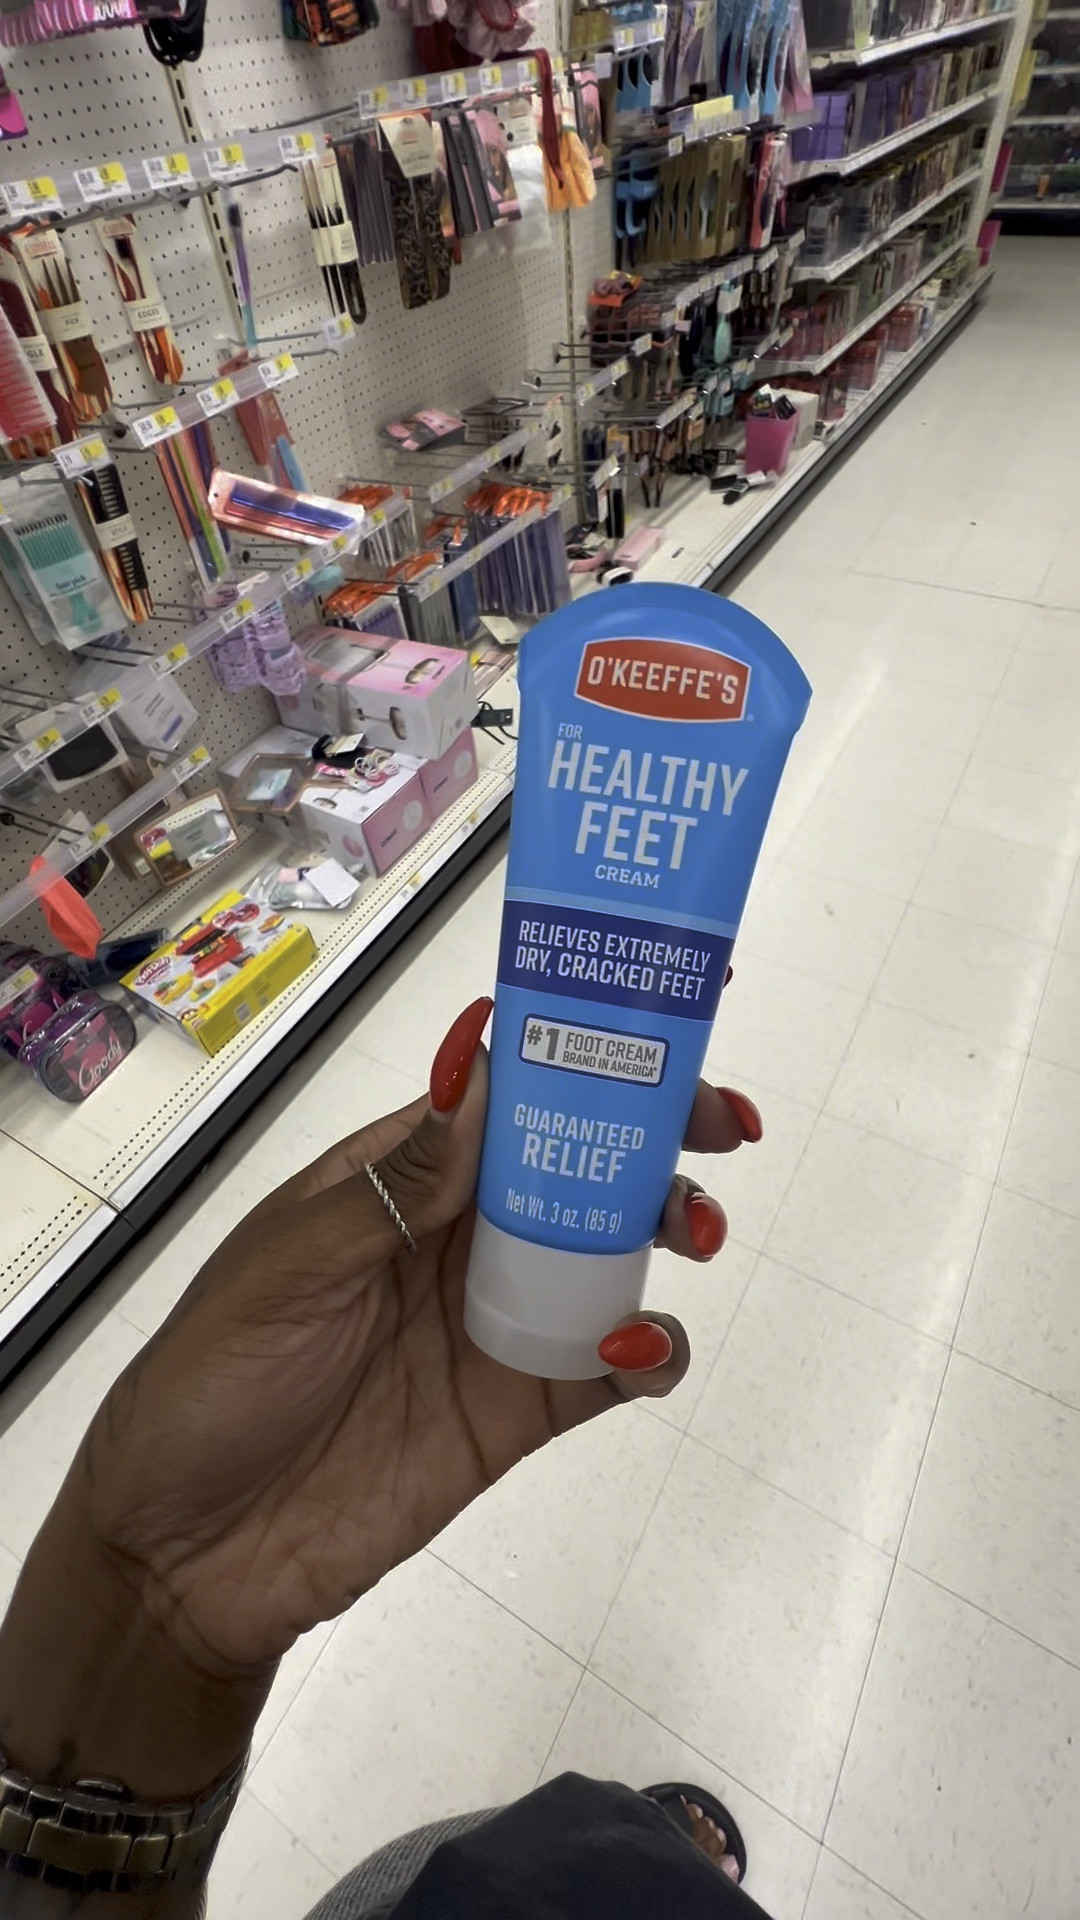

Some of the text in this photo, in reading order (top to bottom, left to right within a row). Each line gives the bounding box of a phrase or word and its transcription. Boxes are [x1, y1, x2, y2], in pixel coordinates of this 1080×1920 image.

[587, 655, 739, 705] O'KEEFFE'S
[558, 722, 583, 740] FOR
[547, 739, 749, 816] HEALTHY
[575, 800, 698, 870] FEET
[594, 865, 661, 888] CREAM
[518, 920, 711, 973] RELIEVES EXTREMELY
[515, 945, 705, 1001] DRY, CRACKED FEET
[79, 1033, 123, 1090] Goody
[526, 1024, 560, 1060] #1
[562, 1051, 596, 1069] BRAND
[597, 1058, 609, 1071] IN
[565, 1032, 658, 1064] FOOT CREAM
[514, 1103, 645, 1151] GUARANTEED
[521, 1133, 627, 1184] RELIEF
[506, 1188, 622, 1235] Net Wt. 3 oz. (85 g)
